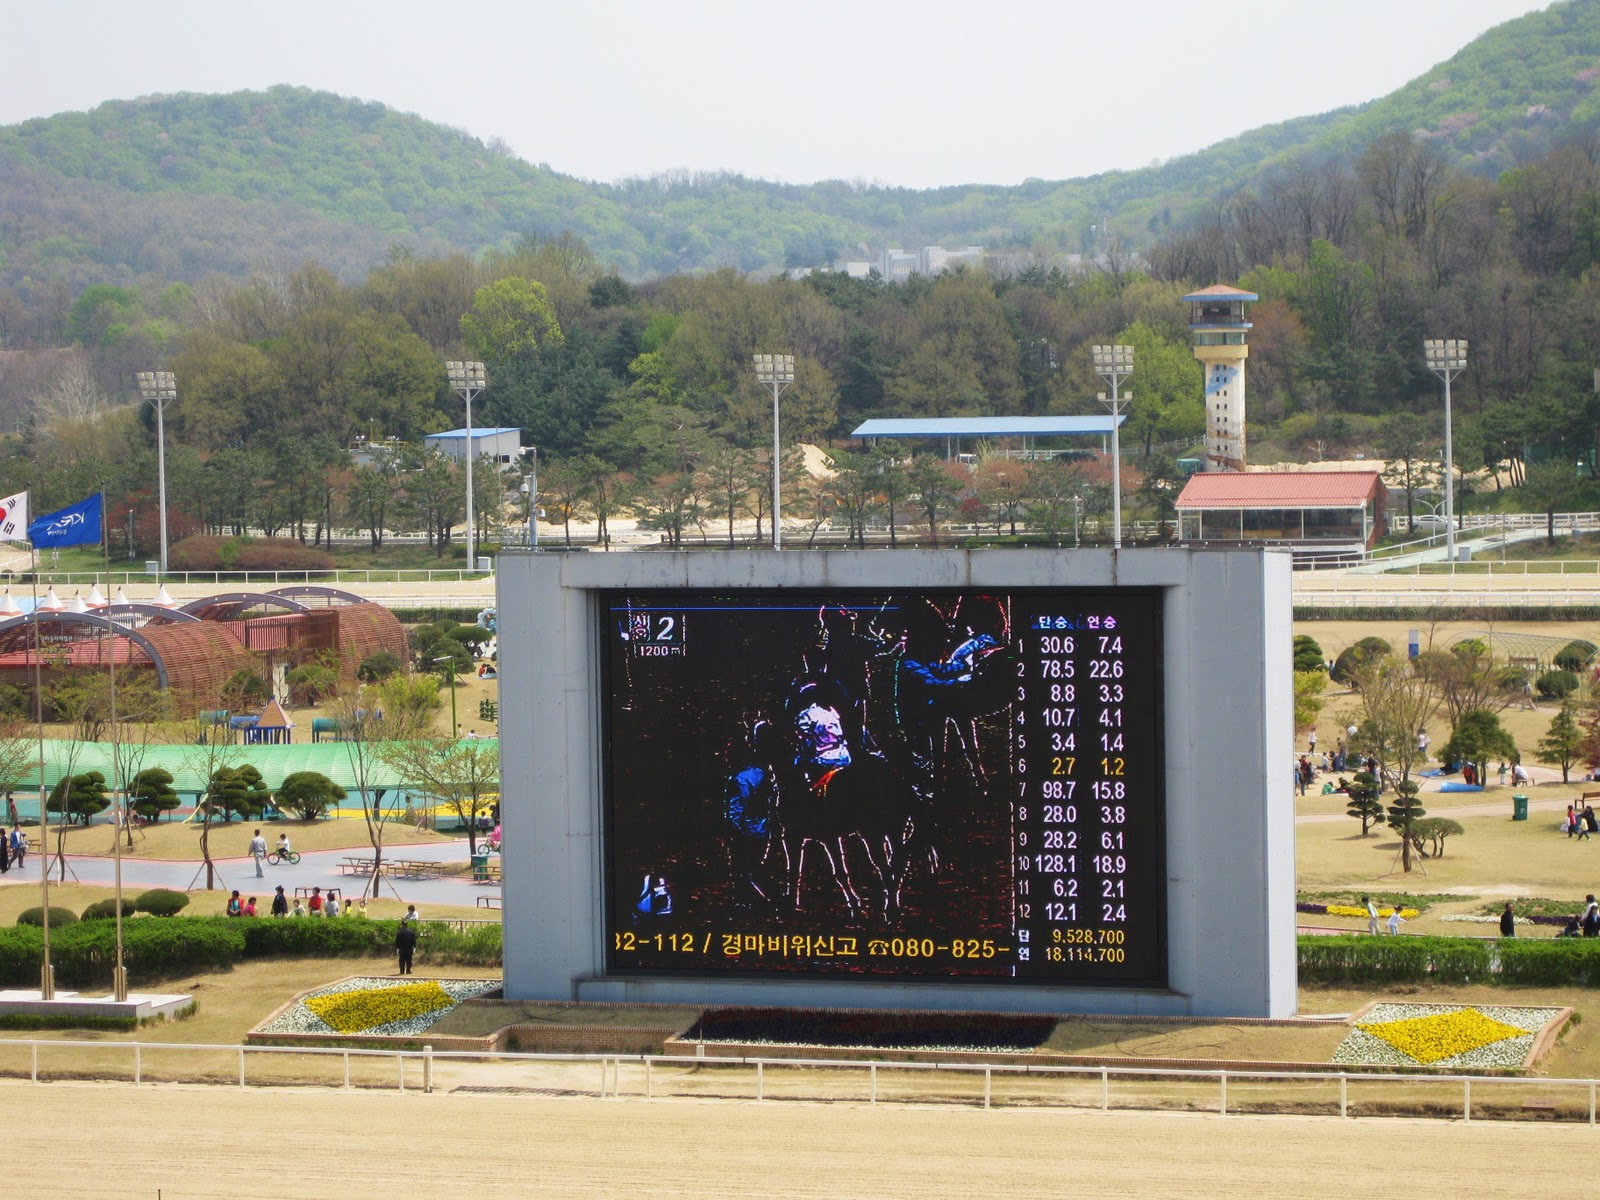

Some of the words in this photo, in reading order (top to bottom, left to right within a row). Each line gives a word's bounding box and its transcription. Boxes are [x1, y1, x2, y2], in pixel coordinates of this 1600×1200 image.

[656, 616, 675, 641] 2
[1039, 616, 1067, 629] 단승
[1087, 616, 1117, 629] 연승
[1018, 639, 1024, 654] 1
[1040, 636, 1074, 654] 30.6
[1098, 636, 1123, 654] 7.4
[1017, 662, 1026, 677] 2
[1040, 660, 1075, 678] 78.5
[1089, 660, 1124, 678] 22.6
[1017, 686, 1026, 701] 3
[1051, 684, 1075, 702] 8.8
[1099, 684, 1124, 702] 3.3
[1017, 710, 1026, 725] 4
[1042, 708, 1076, 726] 10.7
[1099, 708, 1122, 726] 4.1
[1018, 734, 1026, 749] 5
[1051, 732, 1076, 751] 3.4
[1100, 732, 1125, 751] 1.4
[1018, 758, 1026, 773] 6
[1051, 757, 1076, 775] 2.7
[1101, 757, 1125, 775] 1.2
[1019, 782, 1026, 797] 7
[1043, 781, 1076, 800] 98.7
[1091, 781, 1125, 800] 15.8
[1019, 806, 1027, 821] 8
[1043, 805, 1077, 823] 28.0
[1101, 806, 1126, 824] 3.8
[1019, 832, 1027, 846] 9
[1043, 830, 1077, 849] 28.2
[1101, 832, 1124, 850] 6.1
[1018, 856, 1030, 871] 10
[1035, 854, 1076, 873] 128.1
[1092, 855, 1126, 874] 18.9
[1018, 880, 1029, 895] 11
[1053, 879, 1078, 897] 6.2
[1102, 880, 1125, 898] 2.1
[1019, 904, 1031, 918] 12
[1045, 903, 1077, 921] 12.1
[1102, 904, 1127, 922] 2.4
[722, 934, 859, 957] 경마비위신고
